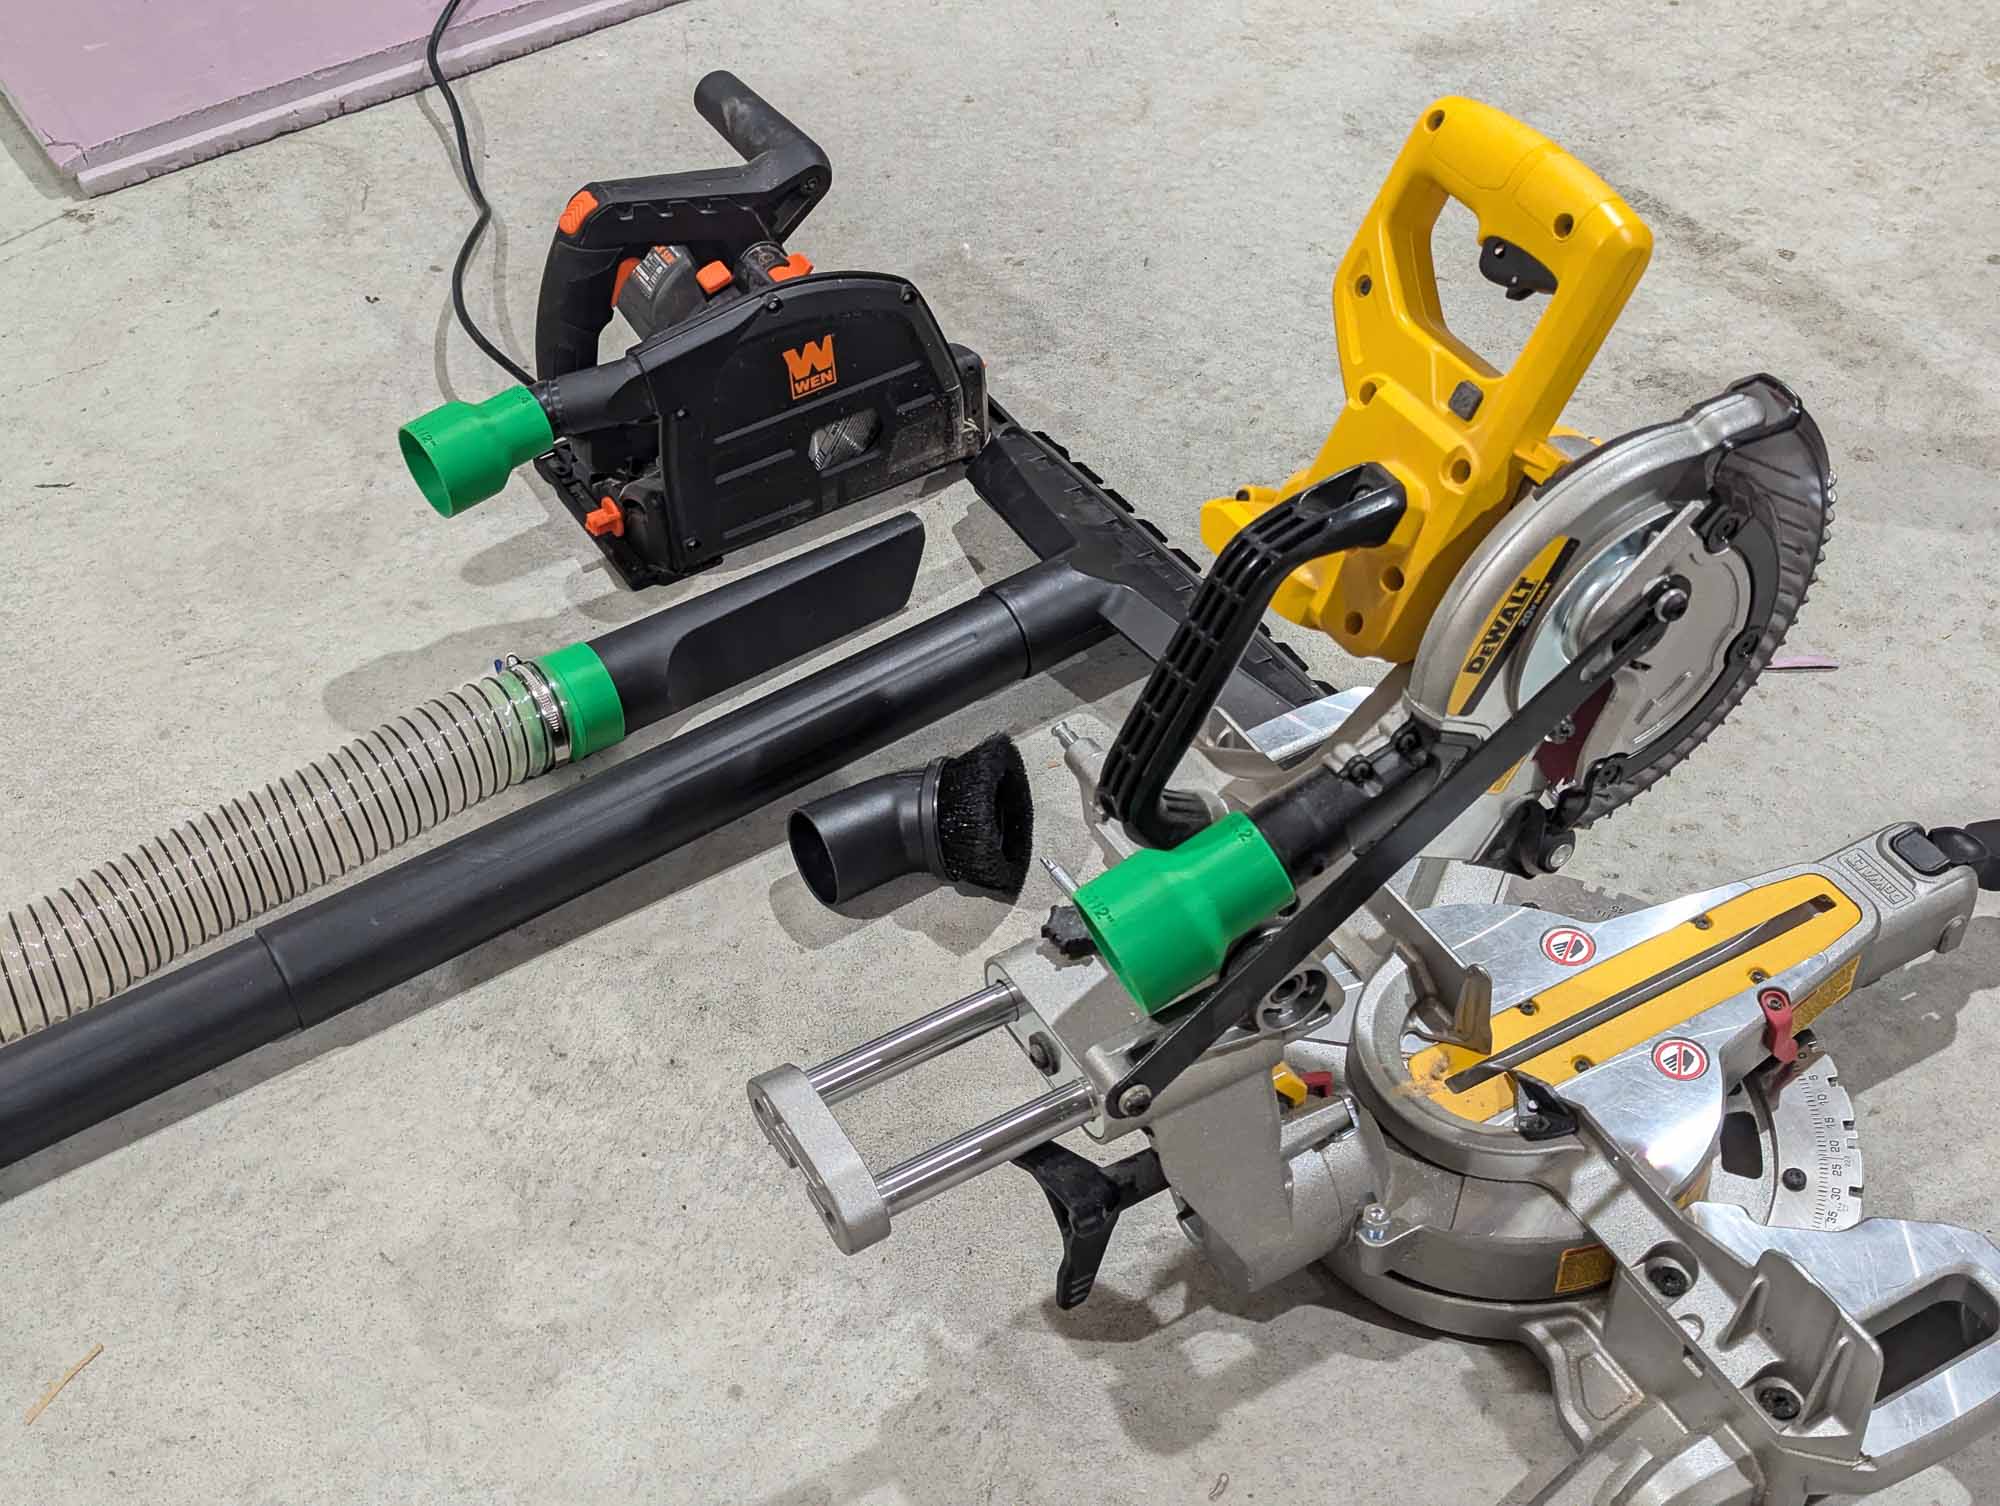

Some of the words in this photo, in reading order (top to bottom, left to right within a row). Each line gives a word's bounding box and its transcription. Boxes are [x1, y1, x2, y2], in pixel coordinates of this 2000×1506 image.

[795, 369, 833, 394] WEN
[1817, 1094, 1829, 1105] 10
[1824, 1117, 1835, 1129] 15
[1830, 1140, 1840, 1153] 20
[1832, 1163, 1842, 1177] 25
[1831, 1187, 1841, 1200] 30
[1827, 1211, 1838, 1224] 35
